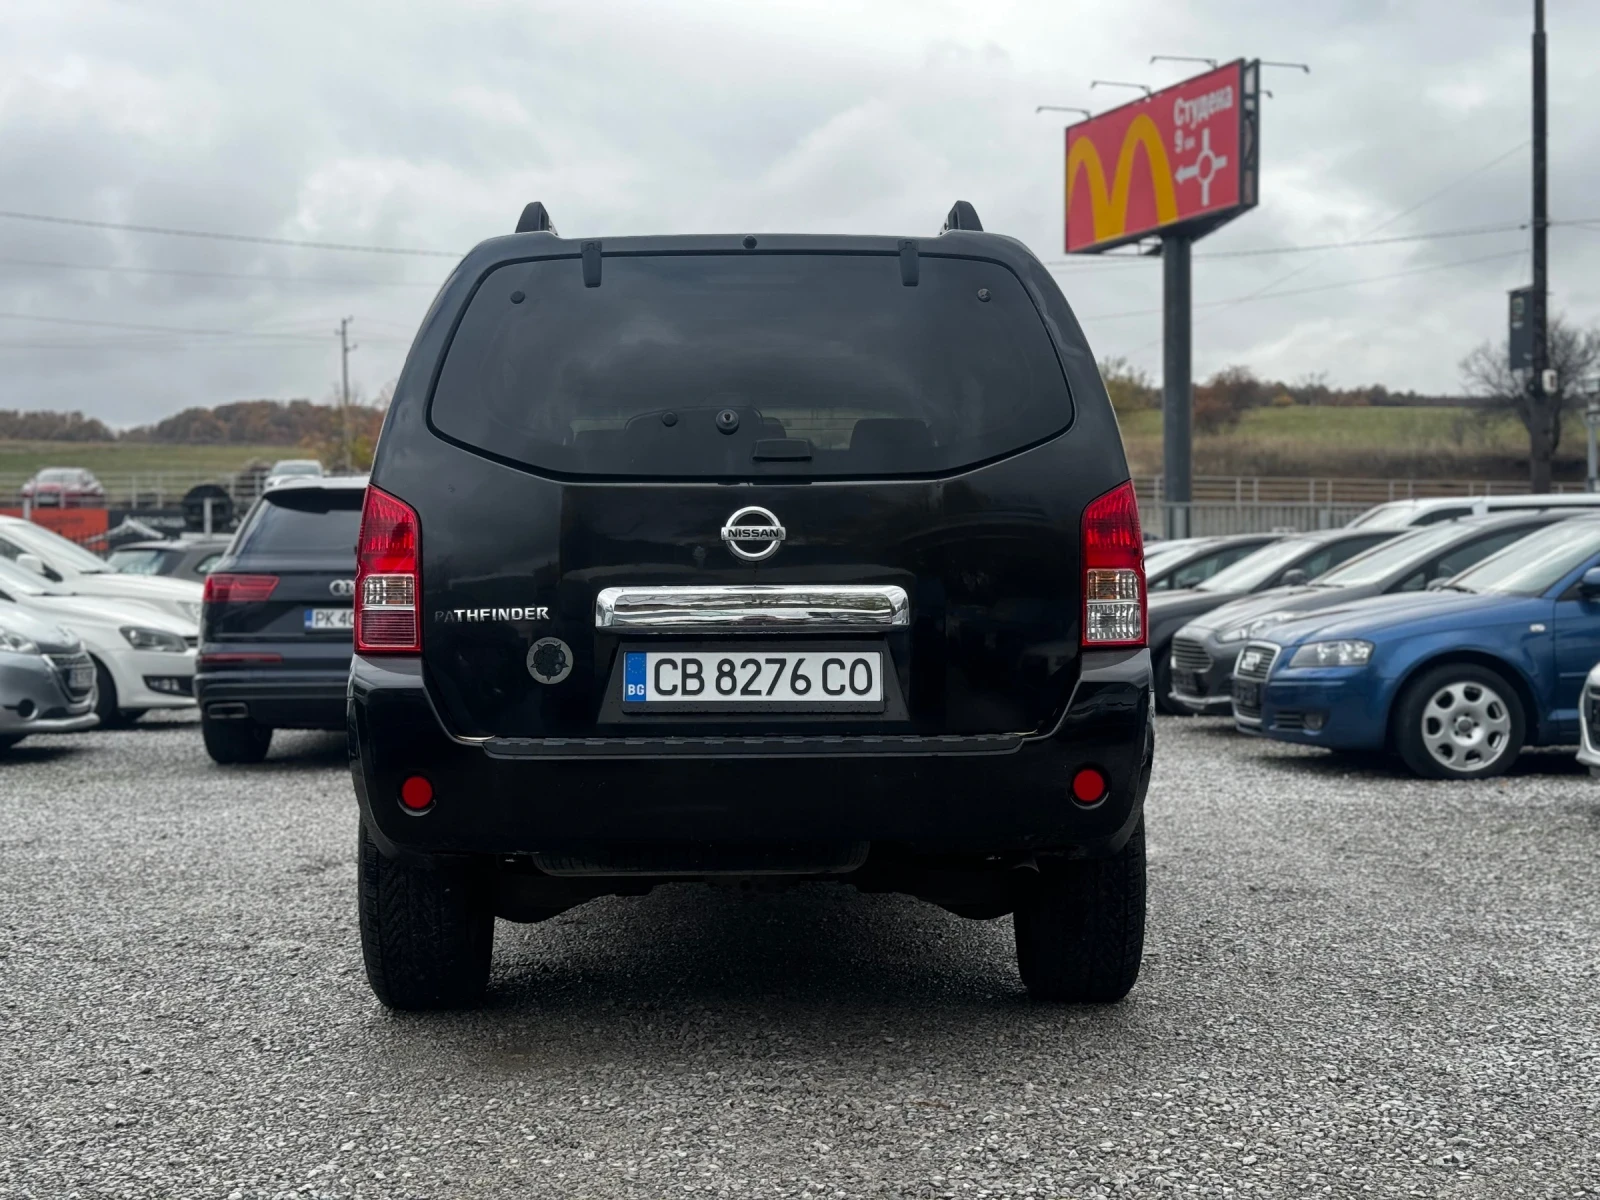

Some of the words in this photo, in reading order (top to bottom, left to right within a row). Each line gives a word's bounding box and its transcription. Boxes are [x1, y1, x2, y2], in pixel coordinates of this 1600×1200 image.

[1174, 129, 1183, 153] 9
[728, 529, 779, 538] NISSAN
[315, 611, 335, 627] PK
[434, 606, 551, 623] PATHFINDER
[654, 658, 705, 696] CB
[715, 658, 812, 696] 8276
[627, 684, 645, 696] BG
